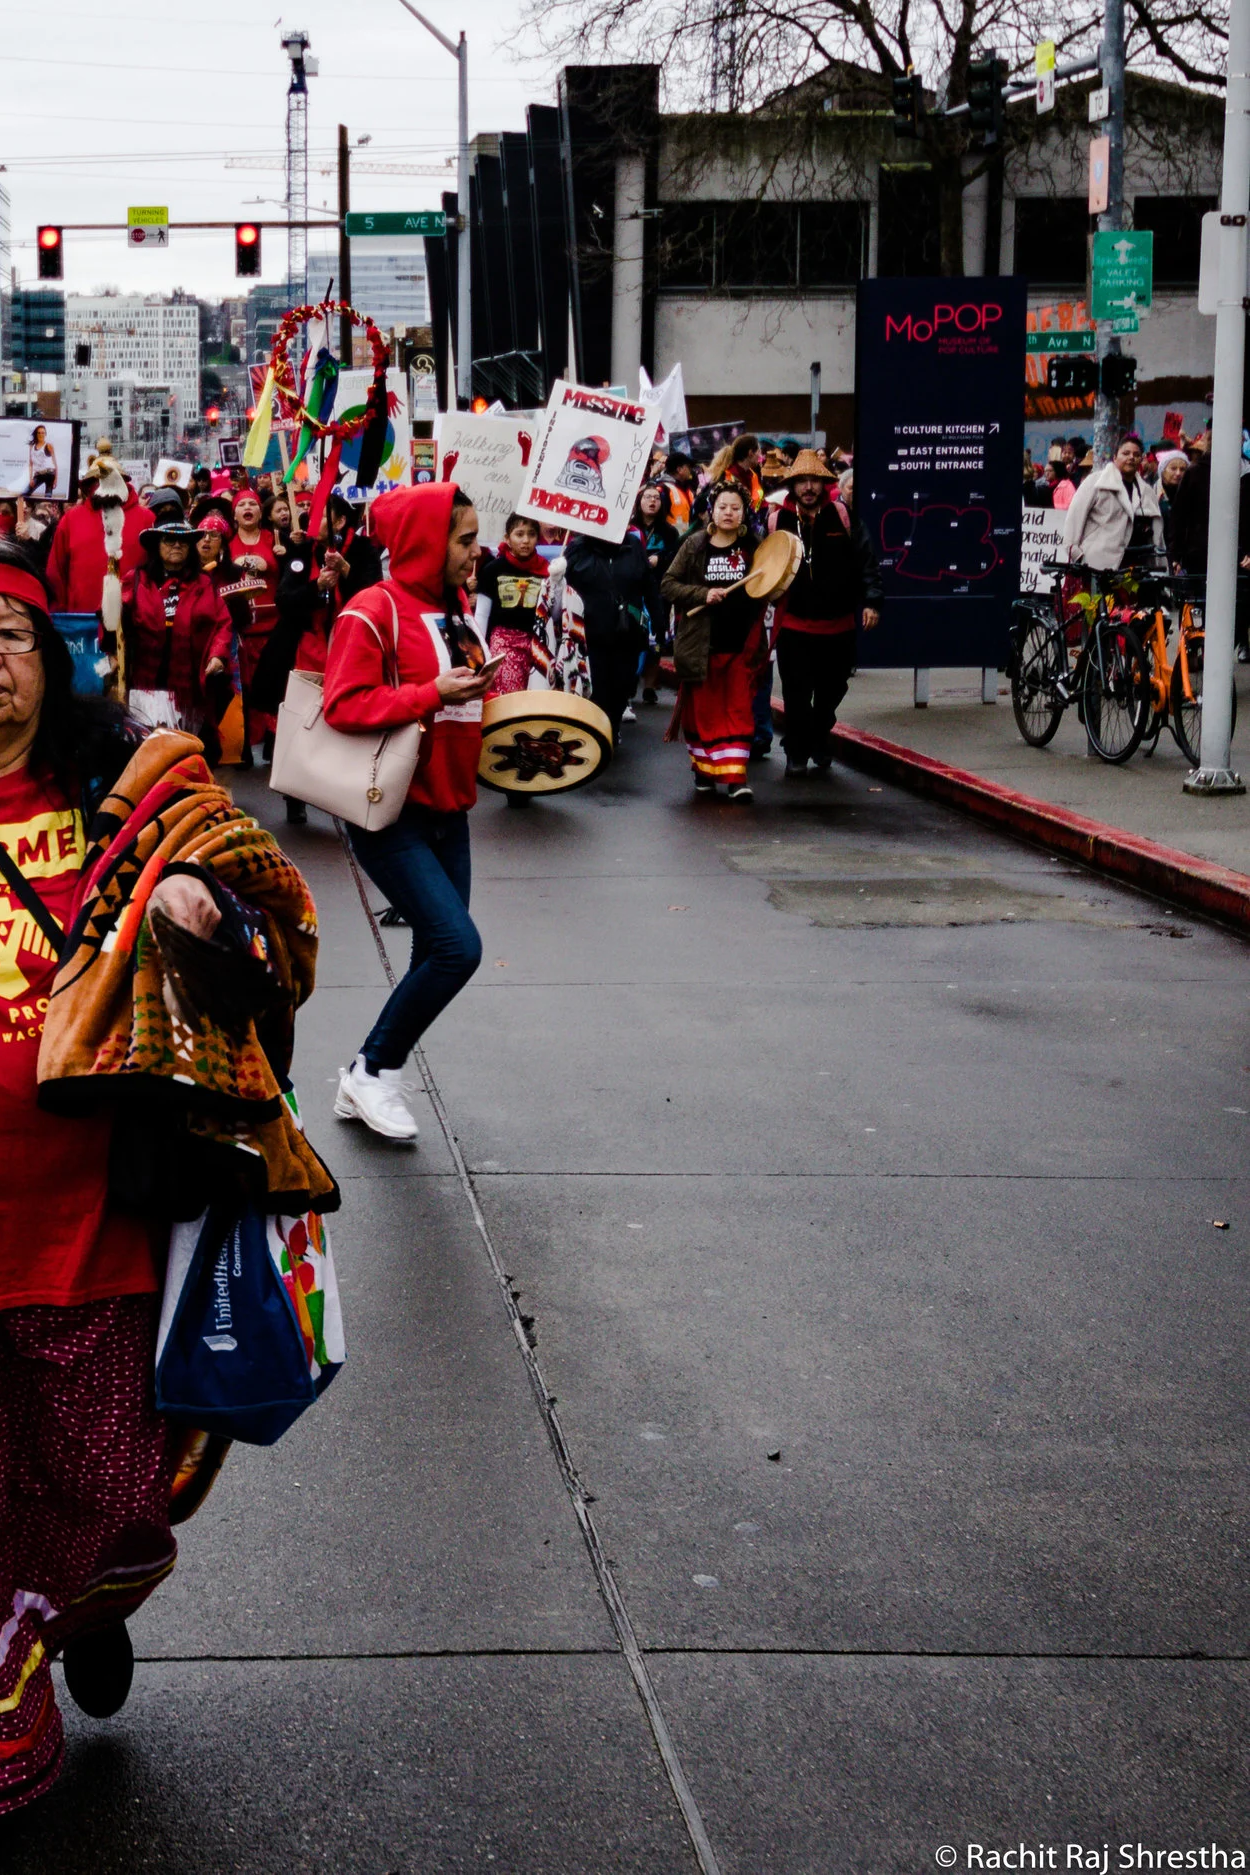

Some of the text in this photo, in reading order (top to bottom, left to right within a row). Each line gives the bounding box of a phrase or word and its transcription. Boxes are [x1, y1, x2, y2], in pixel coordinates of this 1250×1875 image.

[132, 208, 165, 216] TURNING
[364, 215, 445, 229] 5 AVE N
[1107, 268, 1137, 277] VALET
[1099, 278, 1145, 287] PARKING
[885, 303, 1003, 343] MoPOP
[938, 337, 976, 345] MUSEUM
[1027, 334, 1092, 348] th Ave N
[938, 345, 999, 354] POP CULTURE
[561, 388, 646, 426] MISSING
[902, 424, 985, 435] CULTURE KITCHEN
[453, 430, 515, 462] Walking
[909, 446, 984, 456] EAST ENTRANCE
[462, 451, 499, 468] with
[900, 461, 984, 470] SOUTH ENTRANCE
[484, 471, 511, 485] our
[615, 431, 648, 511] WOMEN
[526, 487, 609, 526] MURDERED
[707, 564, 745, 573] RESILINT
[704, 572, 744, 581] NDIGENO
[8, 998, 51, 1024] PRO
[2, 1023, 45, 1043] WACO
[232, 1220, 242, 1277] Commun
